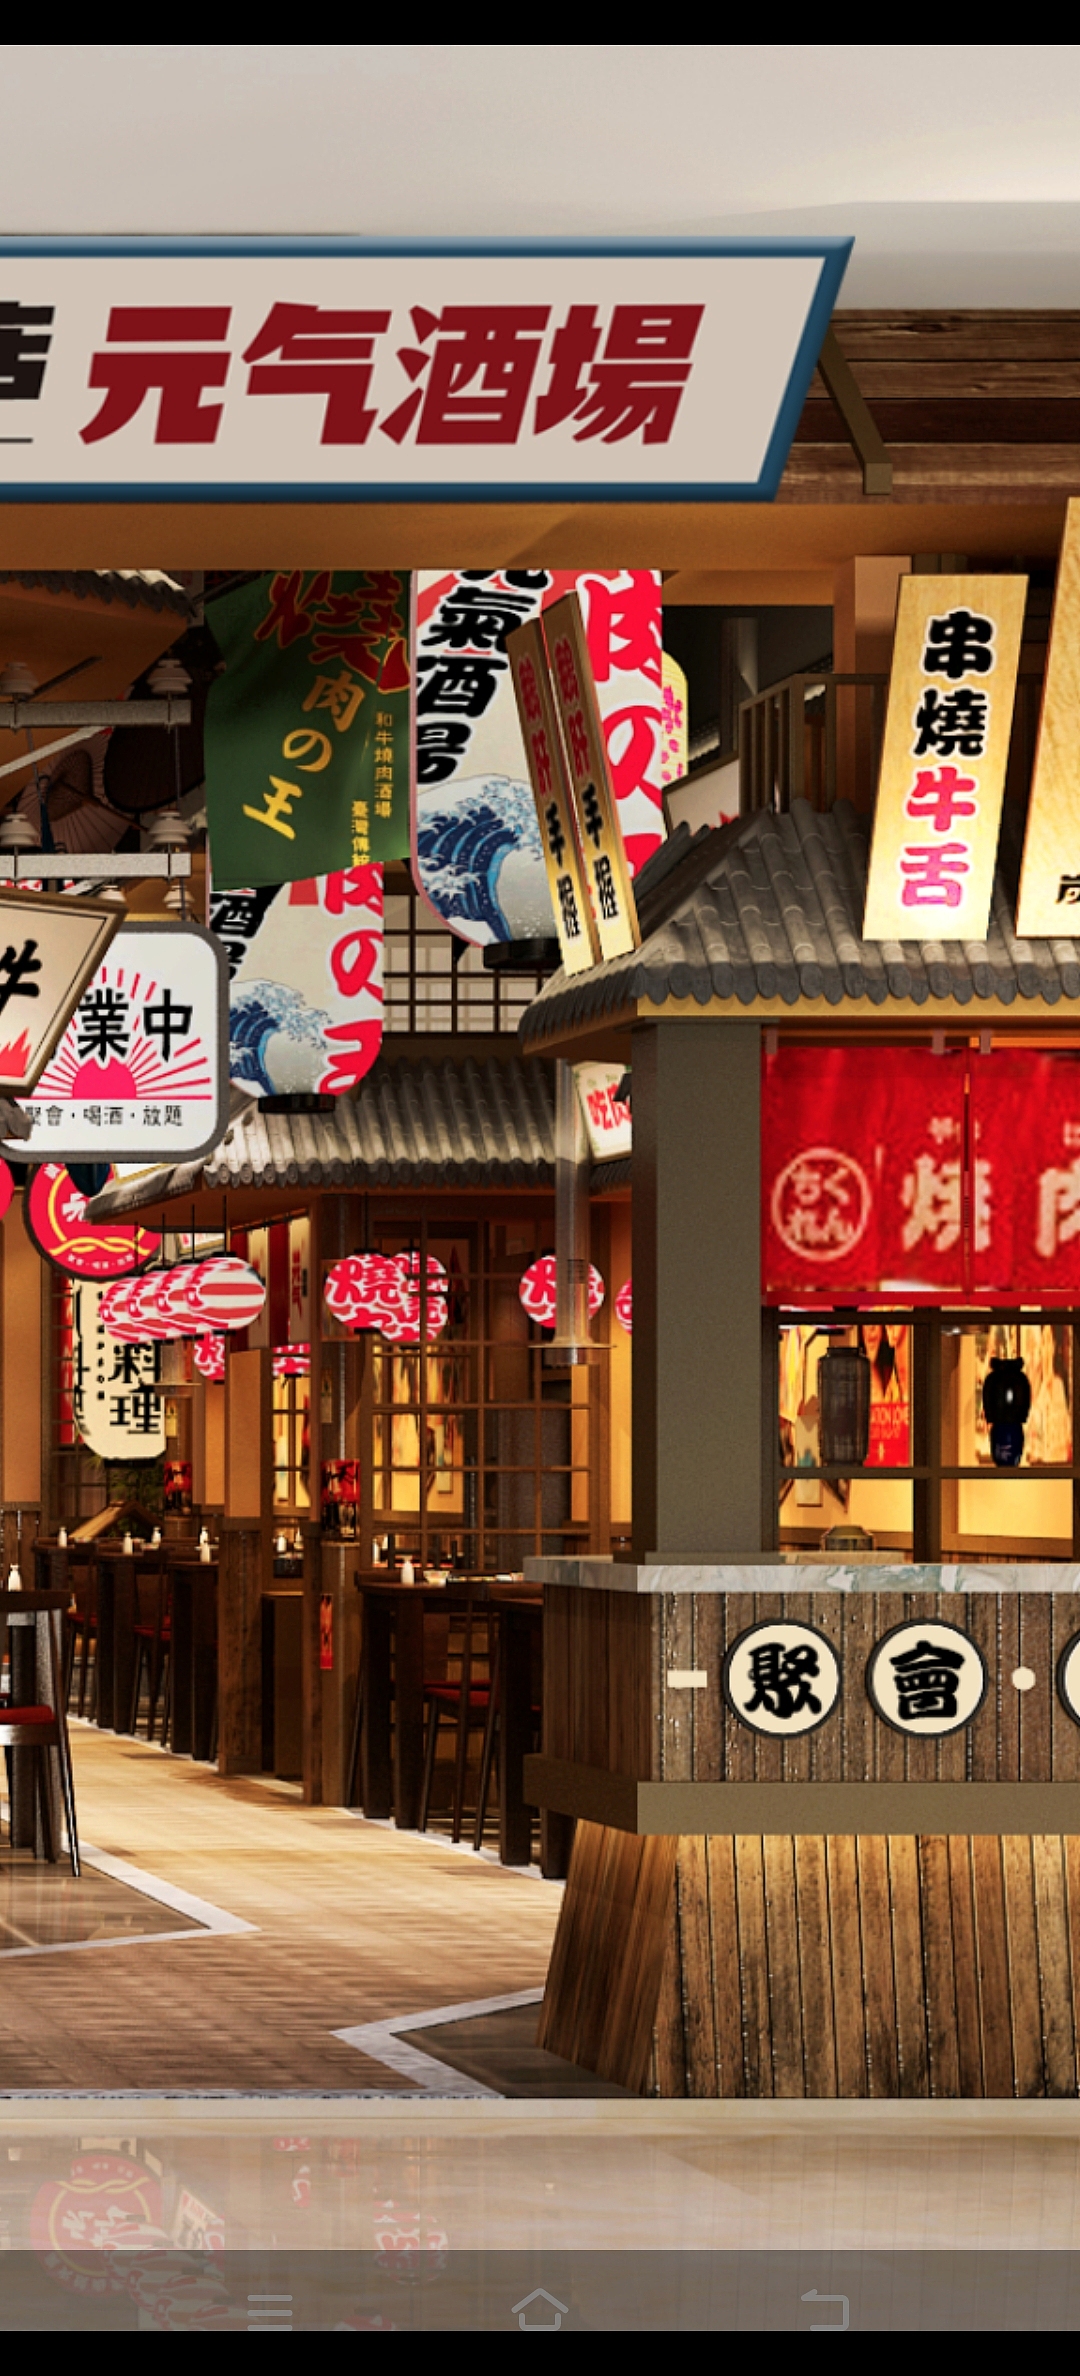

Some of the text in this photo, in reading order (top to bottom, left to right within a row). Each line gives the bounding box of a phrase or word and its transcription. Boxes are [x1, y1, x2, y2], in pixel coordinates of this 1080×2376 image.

[79, 302, 705, 445] 元气酒場
[900, 611, 994, 908] 串燒牛舌
[50, 987, 193, 1063] 業中
